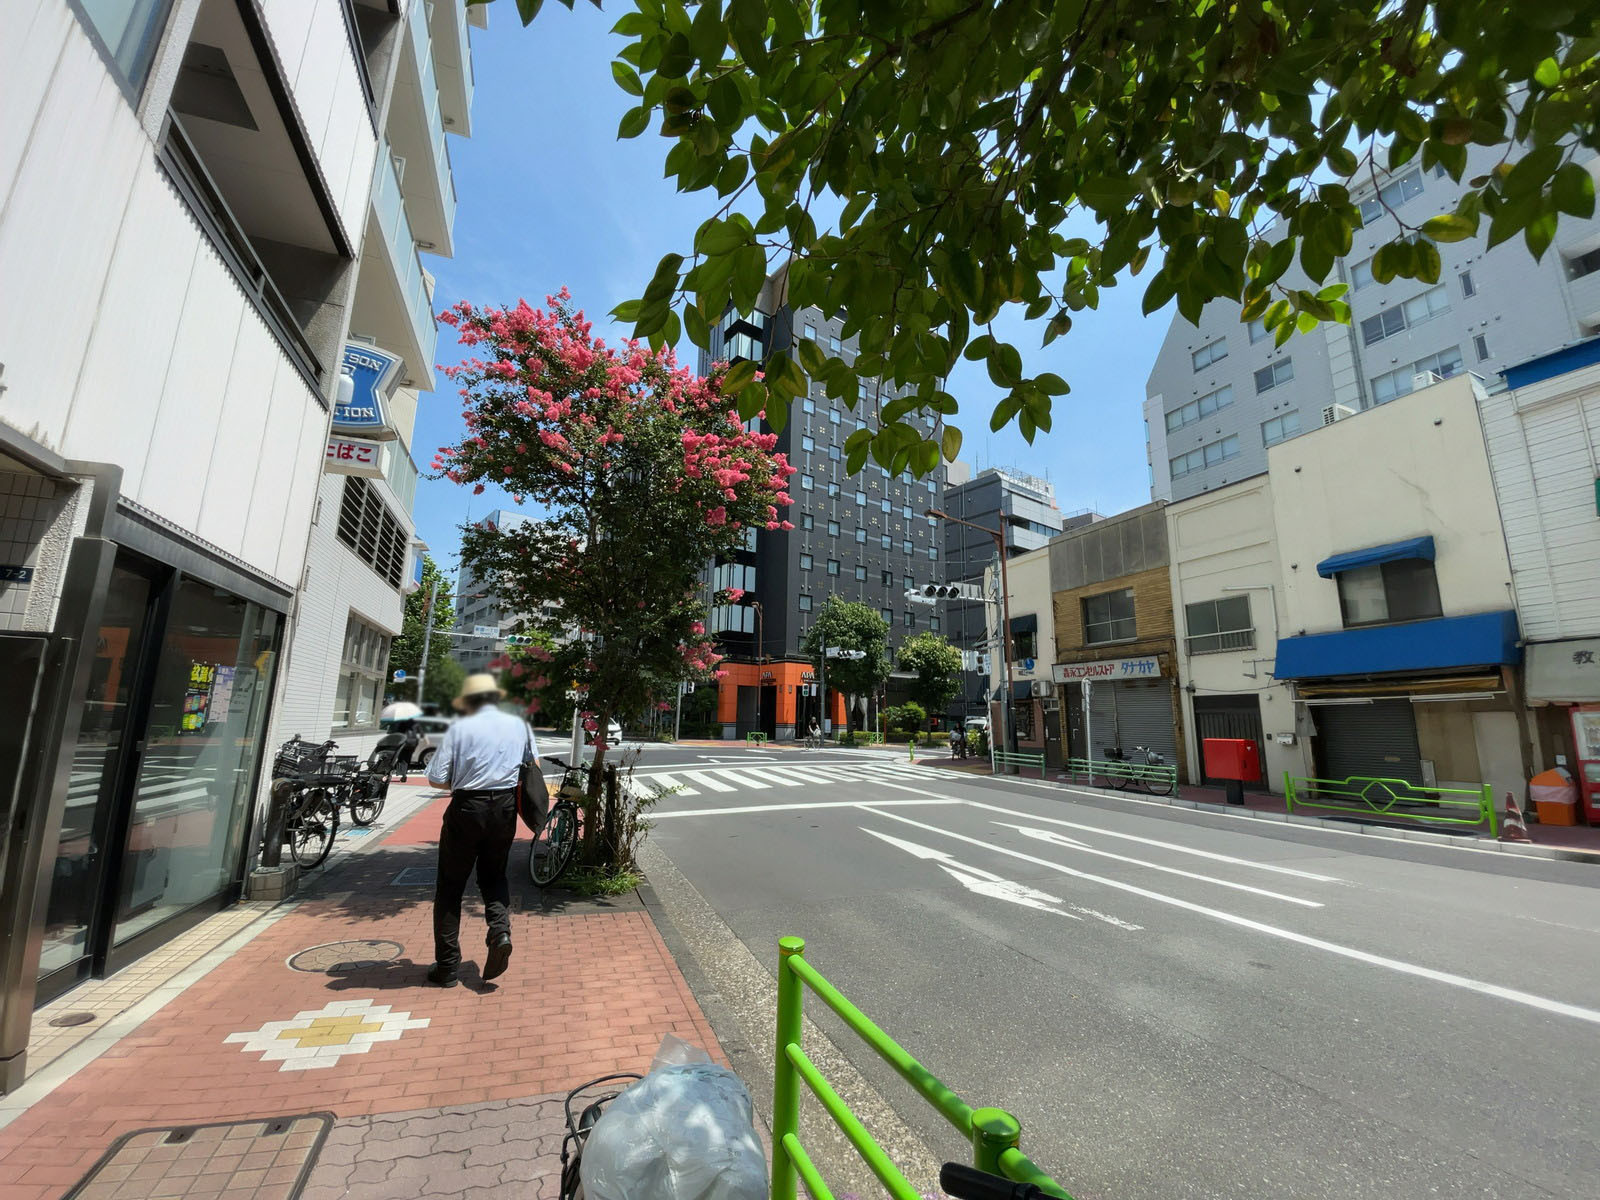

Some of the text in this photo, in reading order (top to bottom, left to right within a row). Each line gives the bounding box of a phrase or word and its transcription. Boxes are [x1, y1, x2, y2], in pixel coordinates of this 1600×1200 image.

[344, 352, 383, 371] SON
[1121, 660, 1155, 675] タナカヤ
